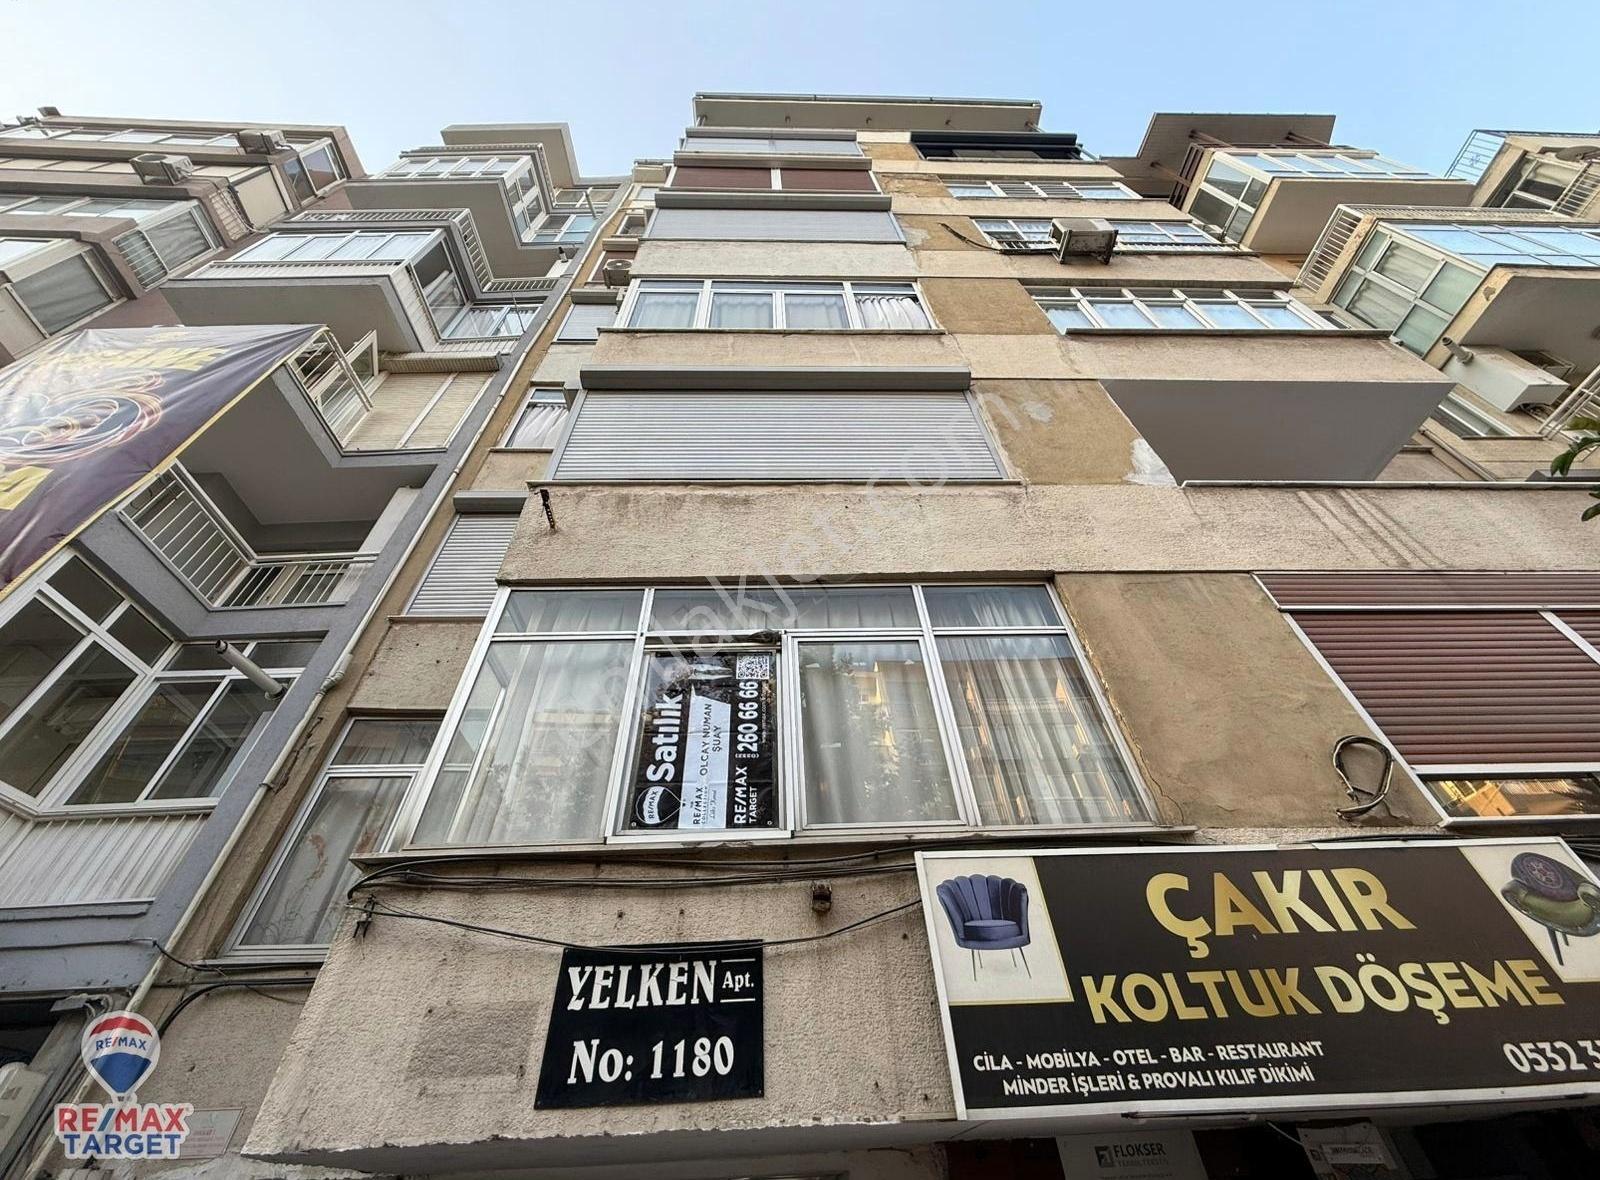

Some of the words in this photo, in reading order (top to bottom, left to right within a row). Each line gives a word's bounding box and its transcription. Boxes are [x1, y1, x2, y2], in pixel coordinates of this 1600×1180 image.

[738, 680, 758, 698] 66
[703, 703, 712, 738] NUMAN
[738, 702, 758, 721] 66
[646, 693, 683, 782] Satılık
[711, 725, 722, 752] ŞUAY
[736, 723, 758, 753] 260
[699, 739, 709, 776] OLCAY
[692, 787, 703, 825] RE/MAX
[733, 766, 747, 824] RE/MAX
[749, 786, 757, 823] TARGET
[1146, 867, 1417, 958] ÇAKIR
[567, 960, 717, 1010] YELKEN
[722, 970, 755, 992] Apt.
[1080, 966, 1323, 1025] KOLTUK
[1313, 953, 1566, 1026] DÖŞEME
[567, 1038, 633, 1084] No:
[650, 1035, 734, 1079] 1180
[972, 1051, 1014, 1072] CİLA
[1026, 1048, 1101, 1070] MOBİLYA
[1112, 1048, 1158, 1066] OTEL
[1169, 1046, 1206, 1064] BAR
[1215, 1041, 1325, 1061] RESTAURANT
[1503, 1041, 1588, 1073] 0532
[1003, 1074, 1071, 1096] MİNDER
[1072, 1071, 1126, 1098] İŞLERİ
[1127, 1078, 1142, 1092] &
[1144, 1070, 1217, 1089] PROVALI
[1218, 1069, 1259, 1087] KILIF
[1259, 1061, 1316, 1084] DİKİMİ
[1113, 1143, 1166, 1158] FLOKSER
